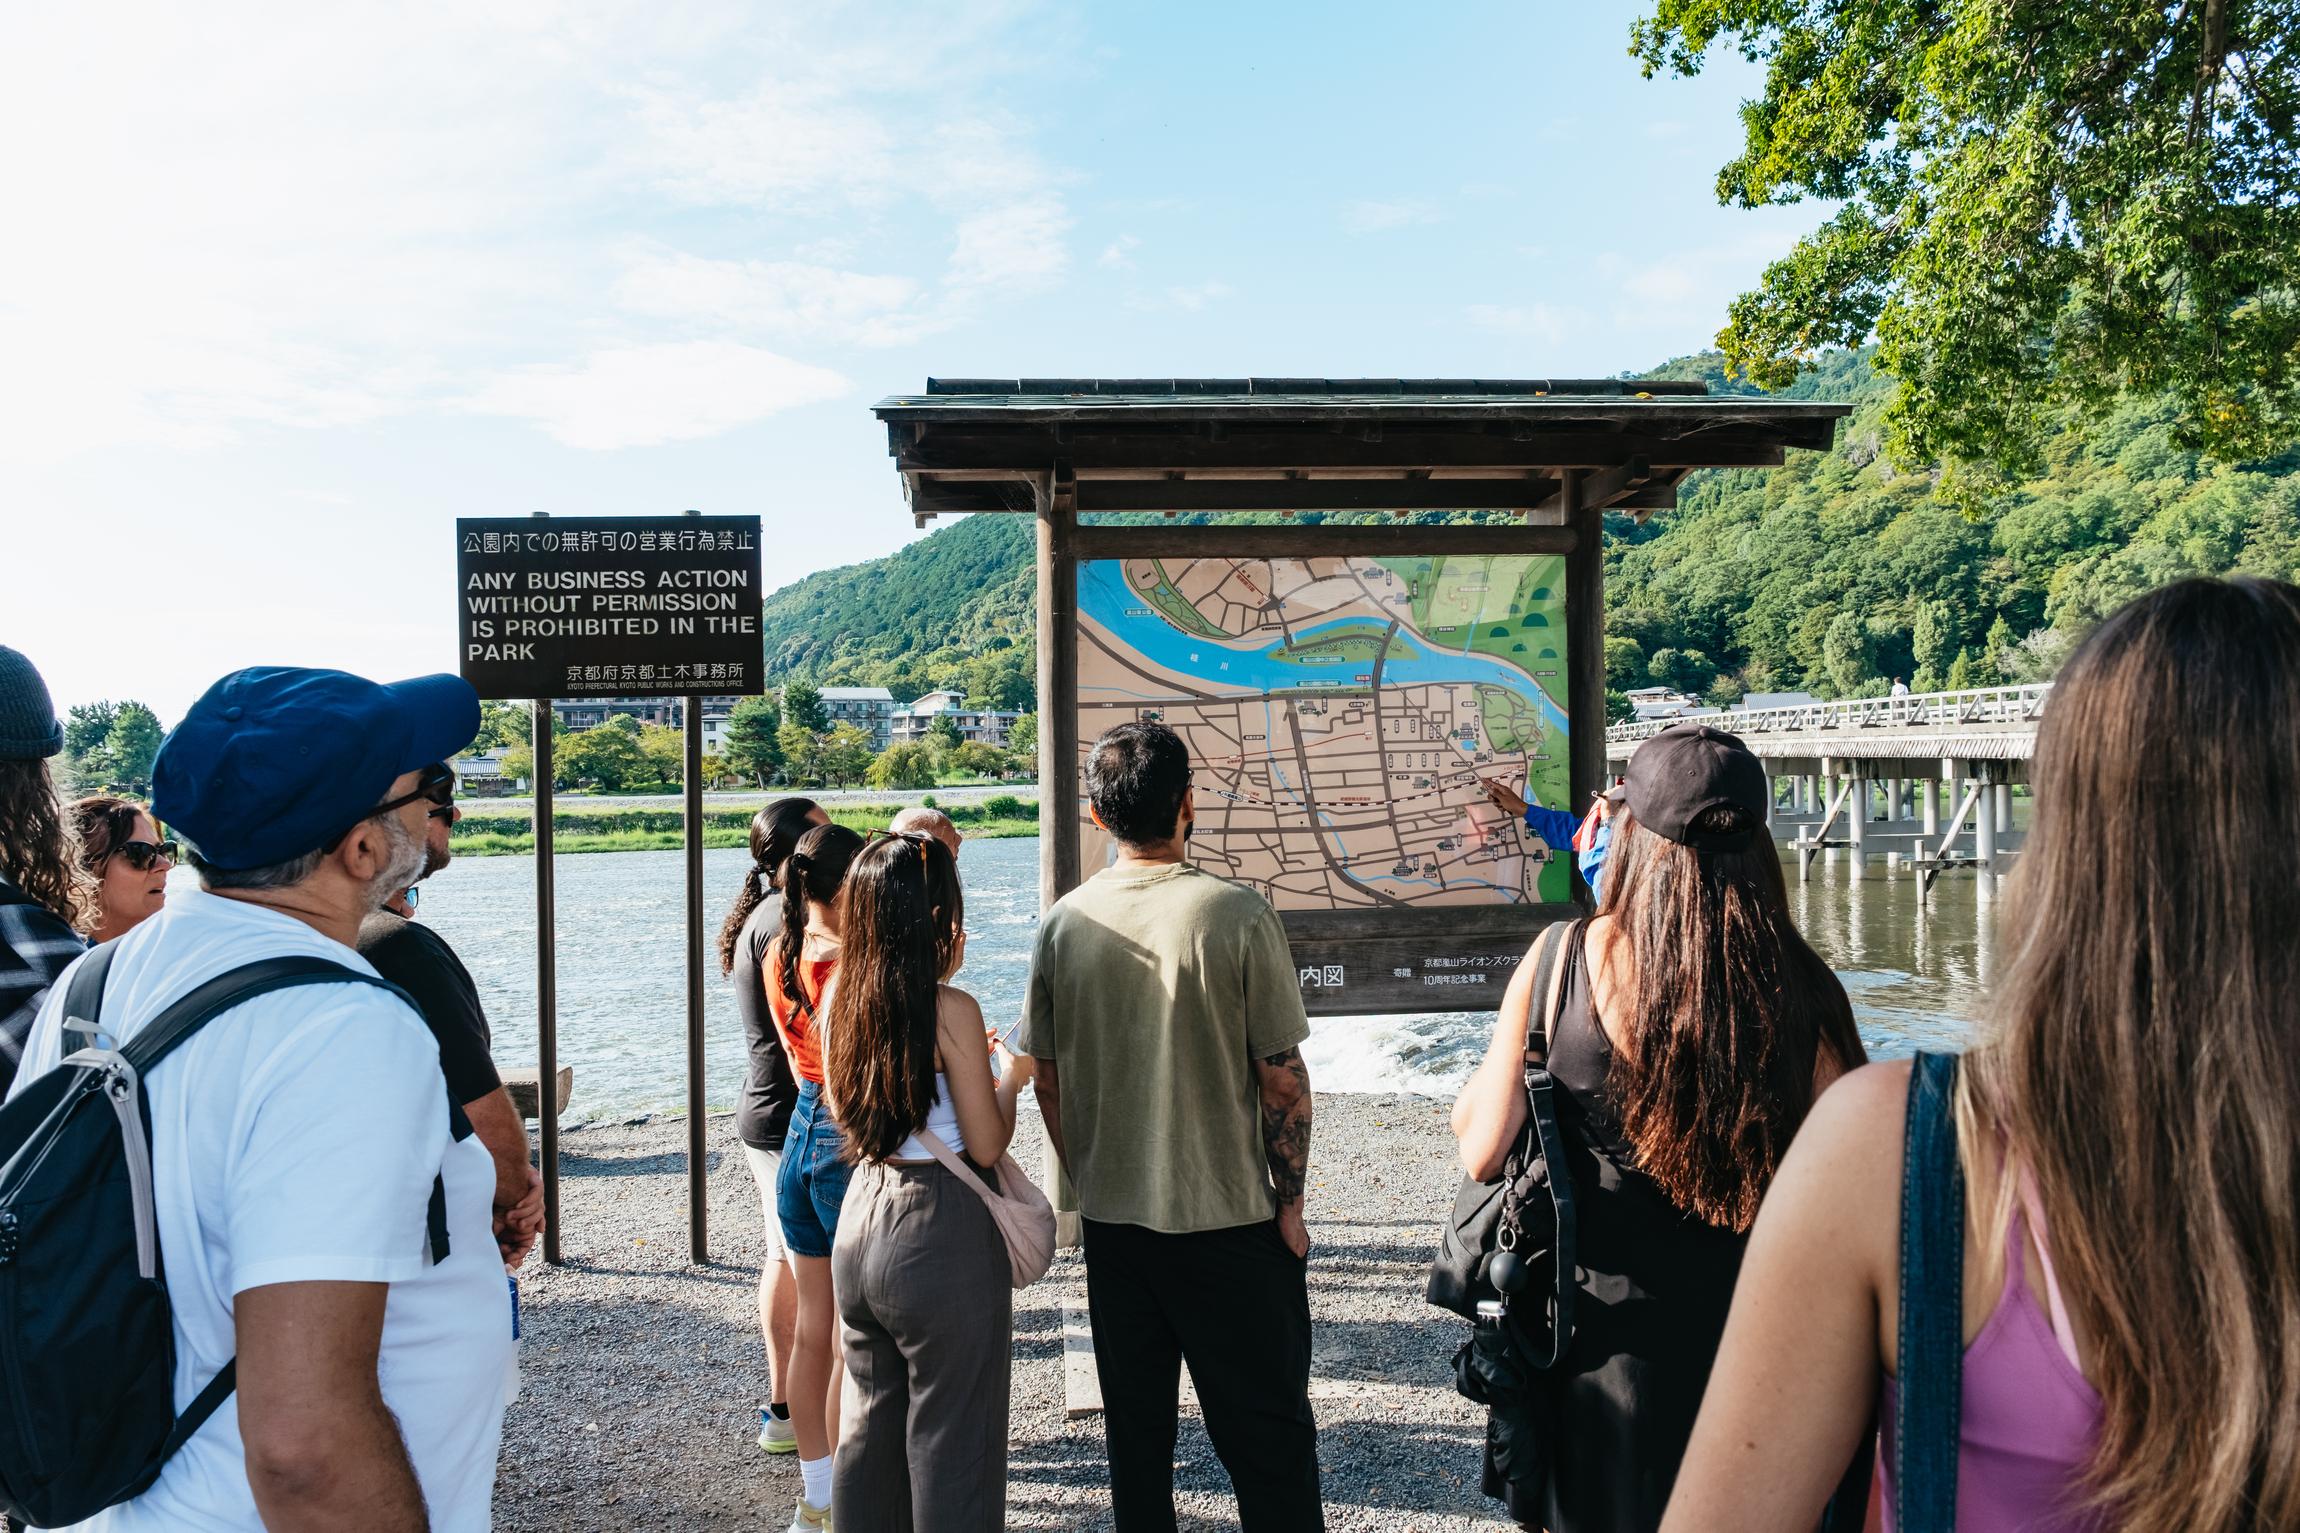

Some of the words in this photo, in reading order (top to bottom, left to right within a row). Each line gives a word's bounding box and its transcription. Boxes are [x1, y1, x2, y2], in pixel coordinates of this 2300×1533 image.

[463, 530, 754, 553] 公園内での無許可の営業行為禁止
[467, 573, 516, 590] ANY
[527, 570, 646, 589] BUSINESS
[657, 569, 748, 588] ACTION
[467, 595, 581, 614] WITHOUT
[592, 593, 737, 612] PERMISSION
[472, 620, 495, 638] IS
[505, 617, 659, 637] PROHIBITED
[670, 616, 695, 634] IN
[704, 616, 755, 634] THE
[468, 643, 535, 662] PARK
[567, 663, 744, 681] 京都府京都土木事務所
[567, 682, 584, 690] KYOTO
[585, 682, 618, 690] PREFECTURAL
[620, 681, 636, 689] KYOTO
[638, 681, 654, 689] PUBLIC
[1424, 955, 1525, 968] 京都嵐山ライオンズクラ
[1423, 973, 1487, 986] 10周年記念事業
